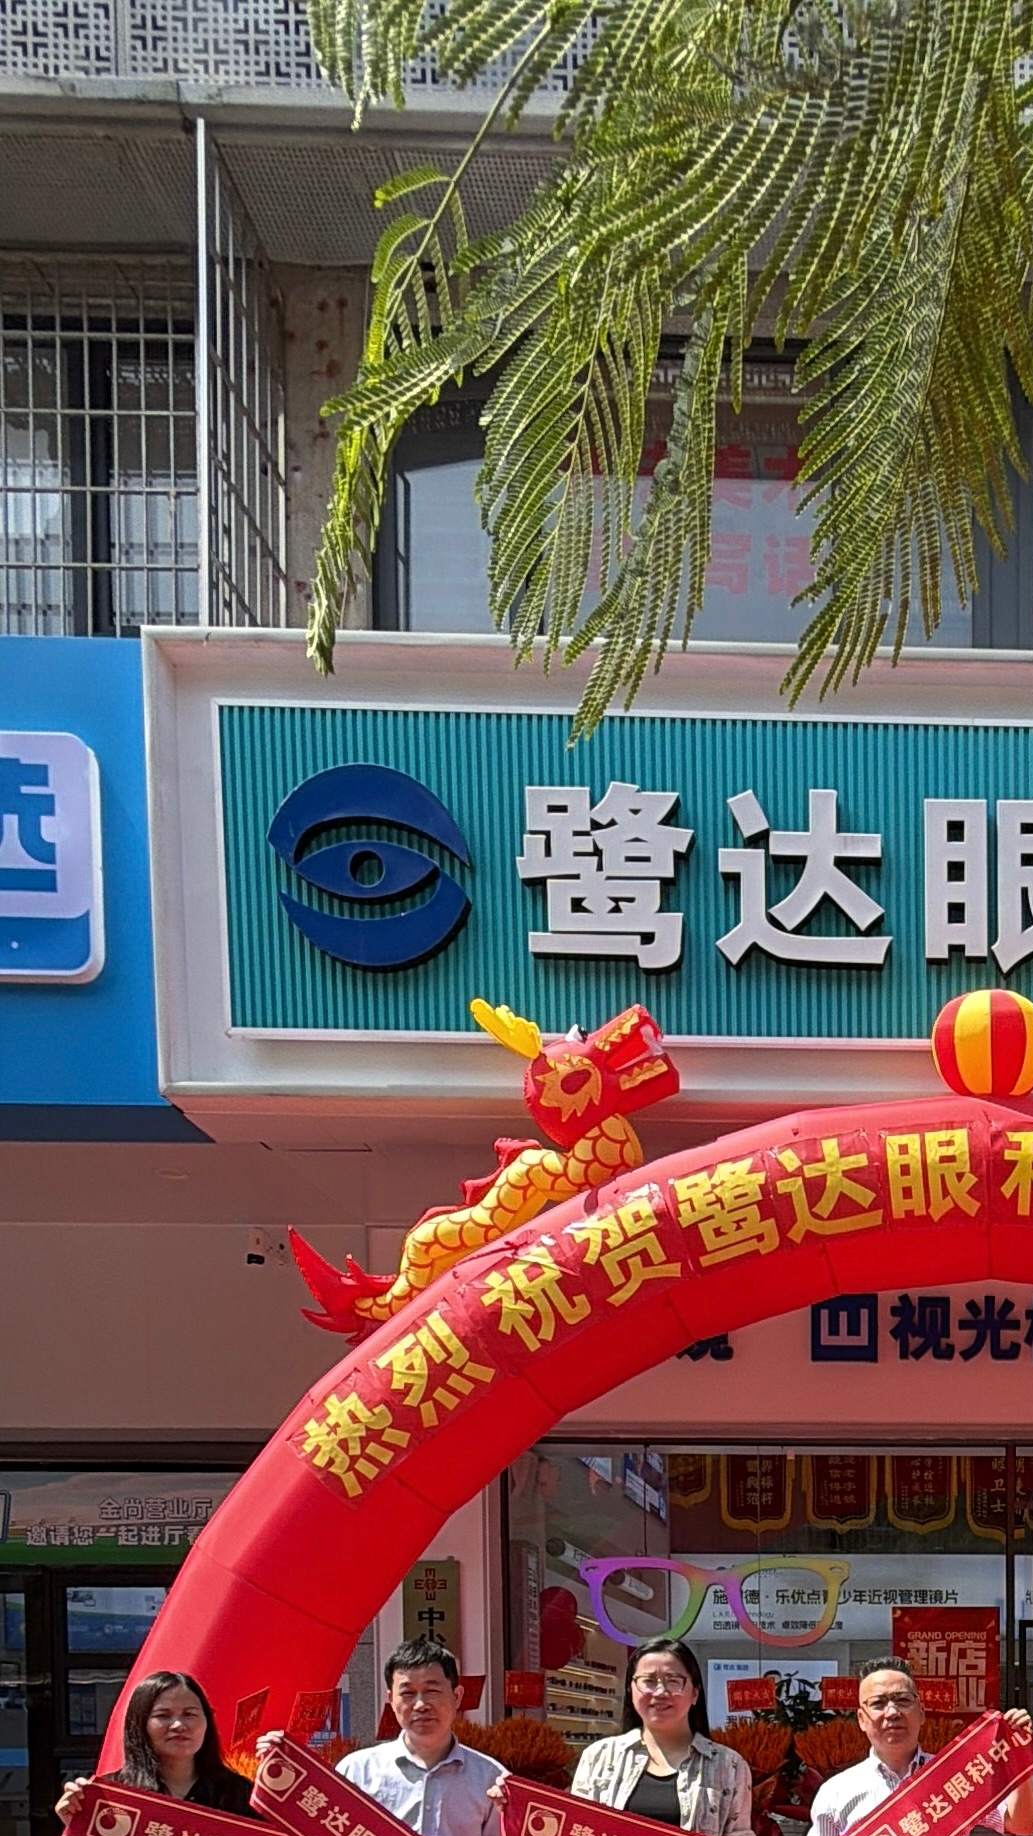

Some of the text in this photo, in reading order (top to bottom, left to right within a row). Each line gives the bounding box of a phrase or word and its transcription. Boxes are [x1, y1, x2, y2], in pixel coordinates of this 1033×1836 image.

[99, 1497, 214, 1520] 金尚营业厅
[907, 1631, 987, 1640] GRAND OPENING
[907, 1640, 987, 1676] 新店
